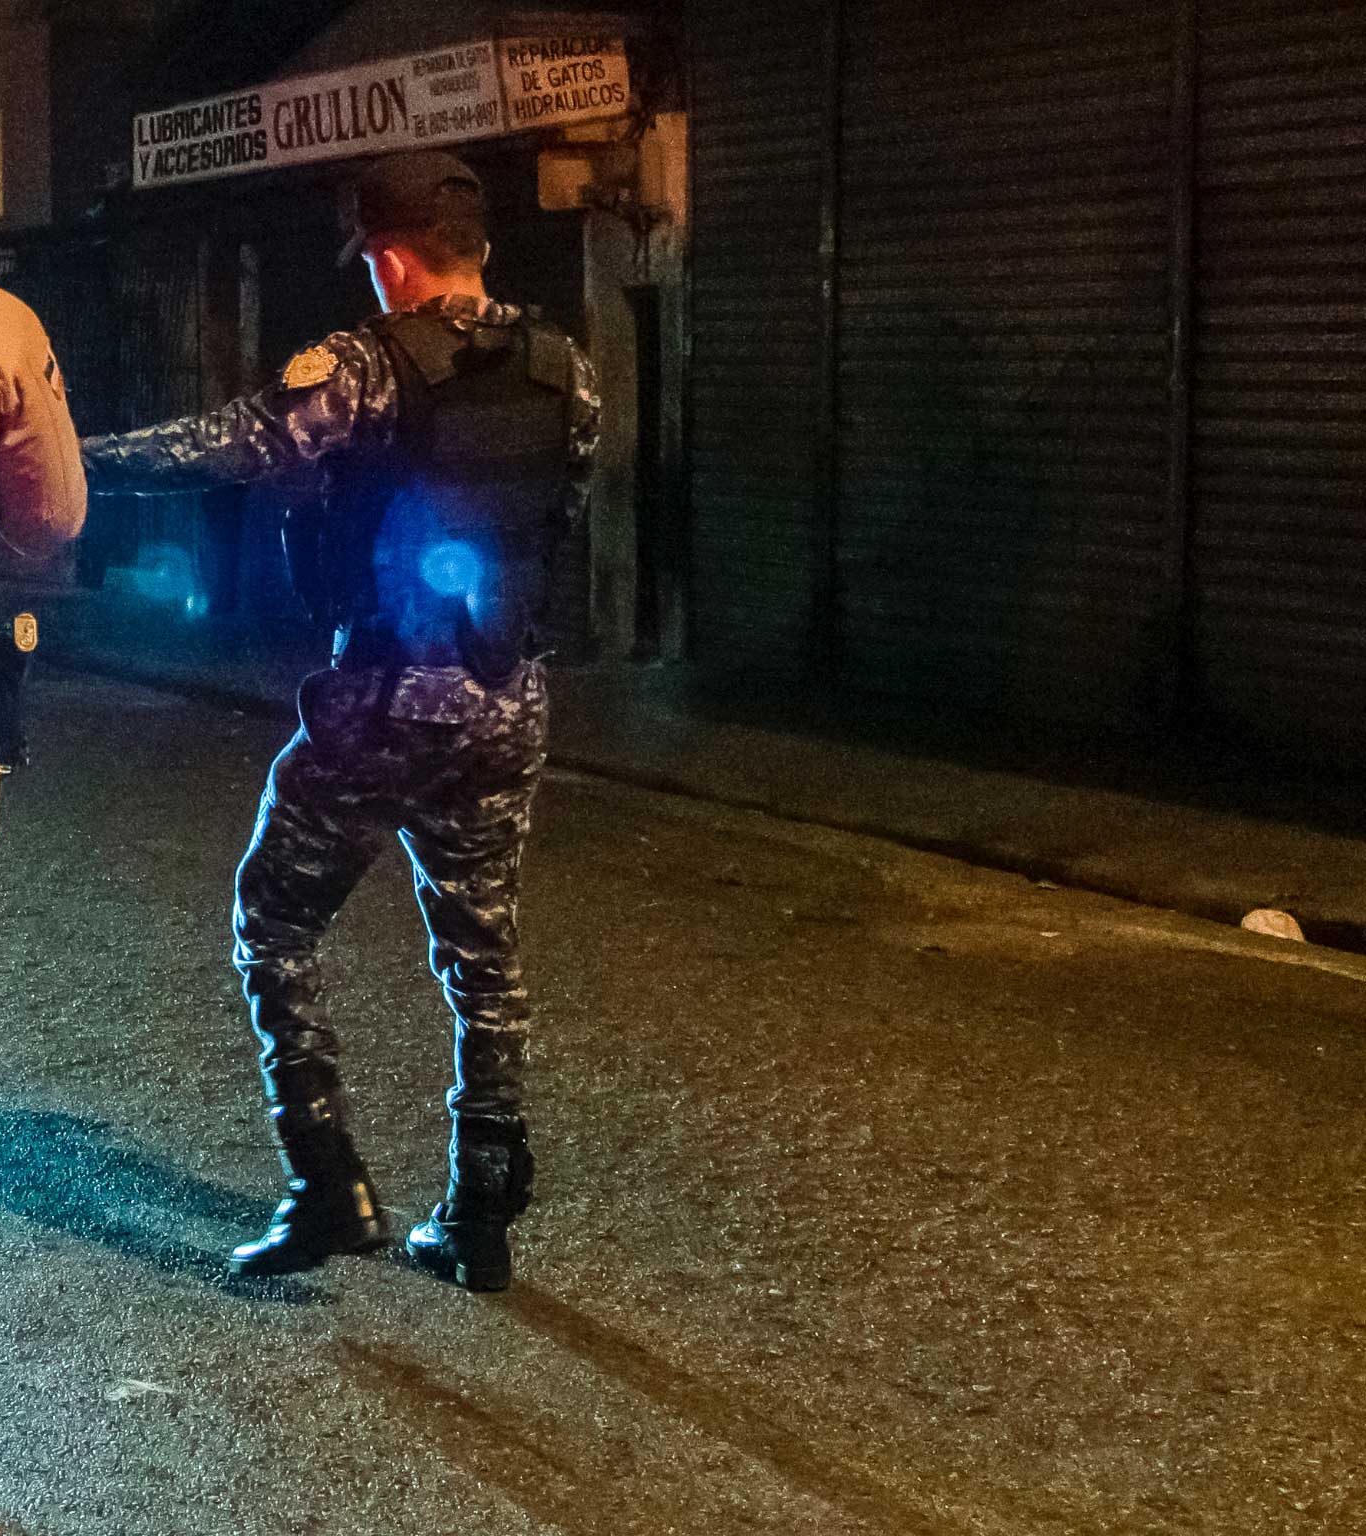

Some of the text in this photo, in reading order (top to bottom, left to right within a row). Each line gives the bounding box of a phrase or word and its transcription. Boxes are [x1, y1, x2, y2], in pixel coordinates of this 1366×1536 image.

[514, 82, 626, 118] HIDRAULICOS
[520, 58, 606, 92] DE GATOS
[137, 93, 262, 146] LUBRICANTES
[273, 75, 409, 150] GRULLON
[138, 129, 268, 181] Y ACCESORIOS
